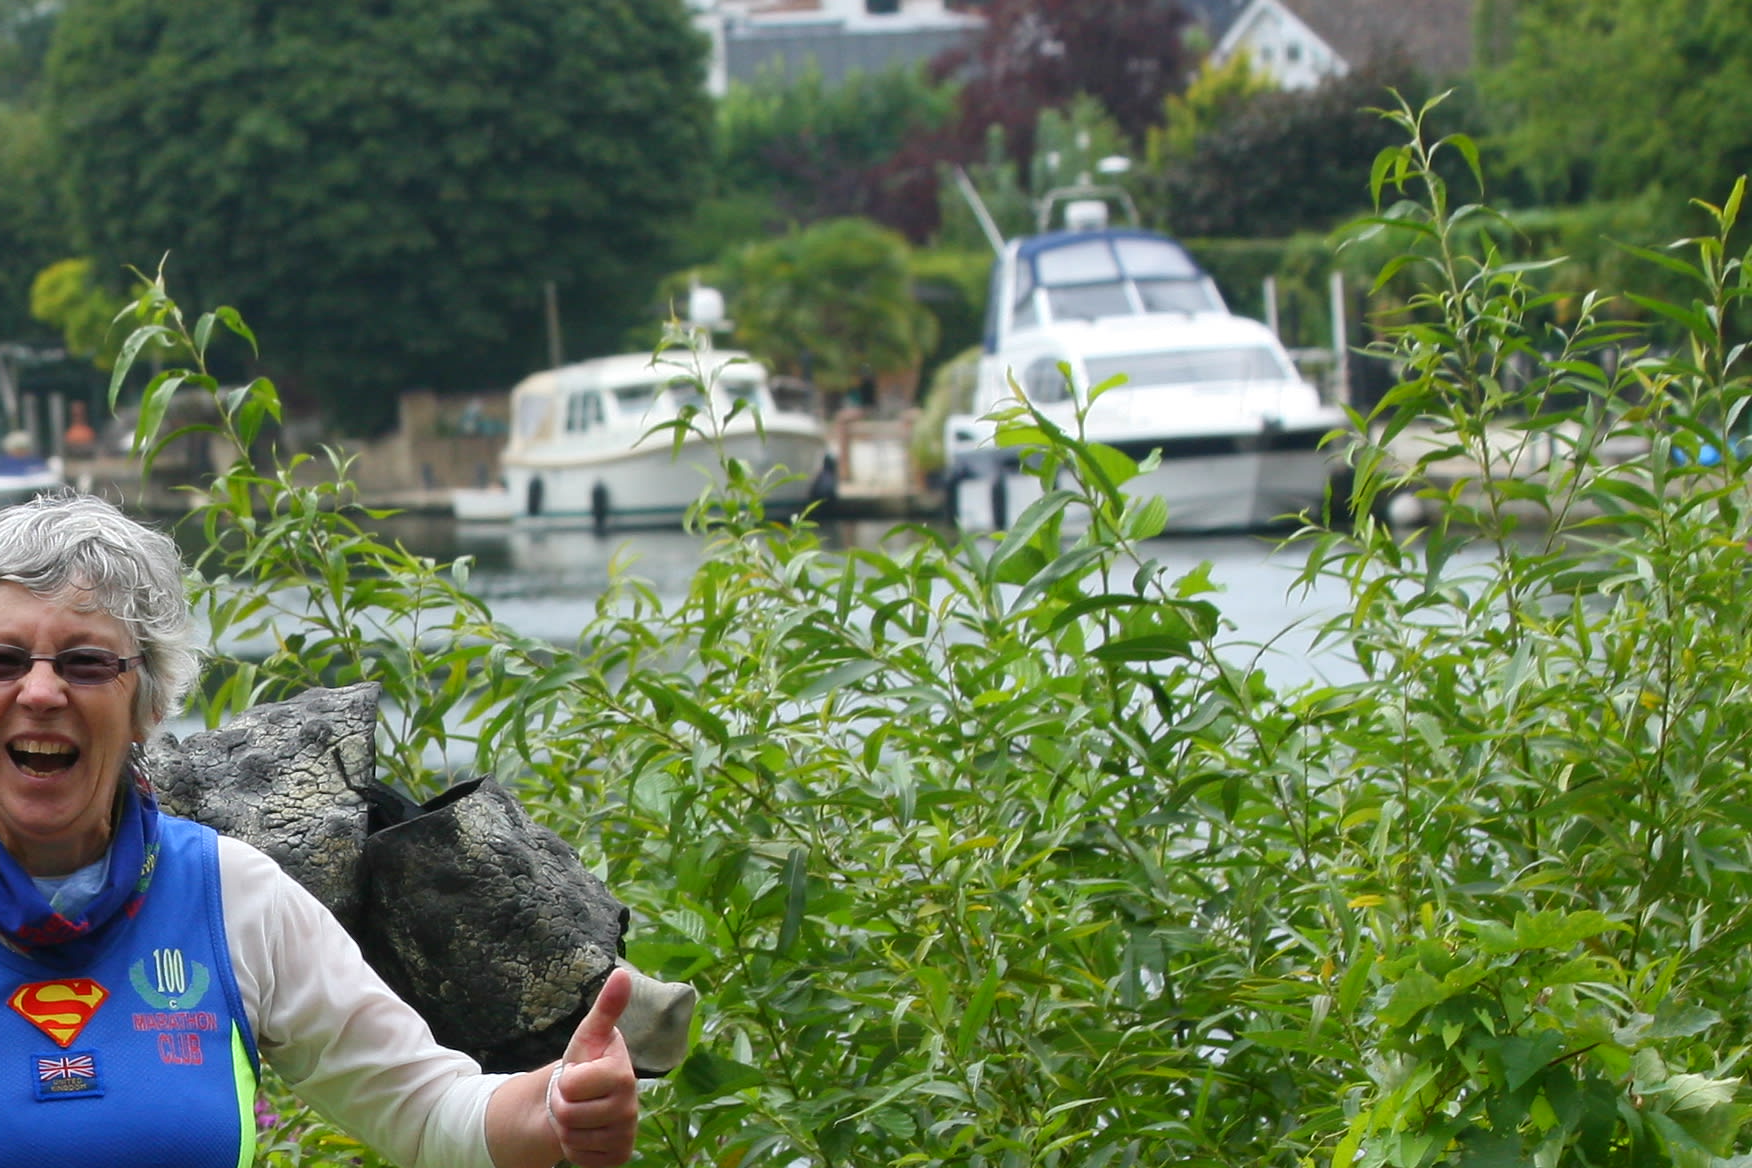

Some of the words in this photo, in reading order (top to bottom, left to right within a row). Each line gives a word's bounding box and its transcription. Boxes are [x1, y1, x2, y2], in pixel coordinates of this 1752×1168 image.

[152, 948, 186, 993] 100
[132, 1011, 218, 1031] MARATHON
[157, 1032, 203, 1065] CLUB
